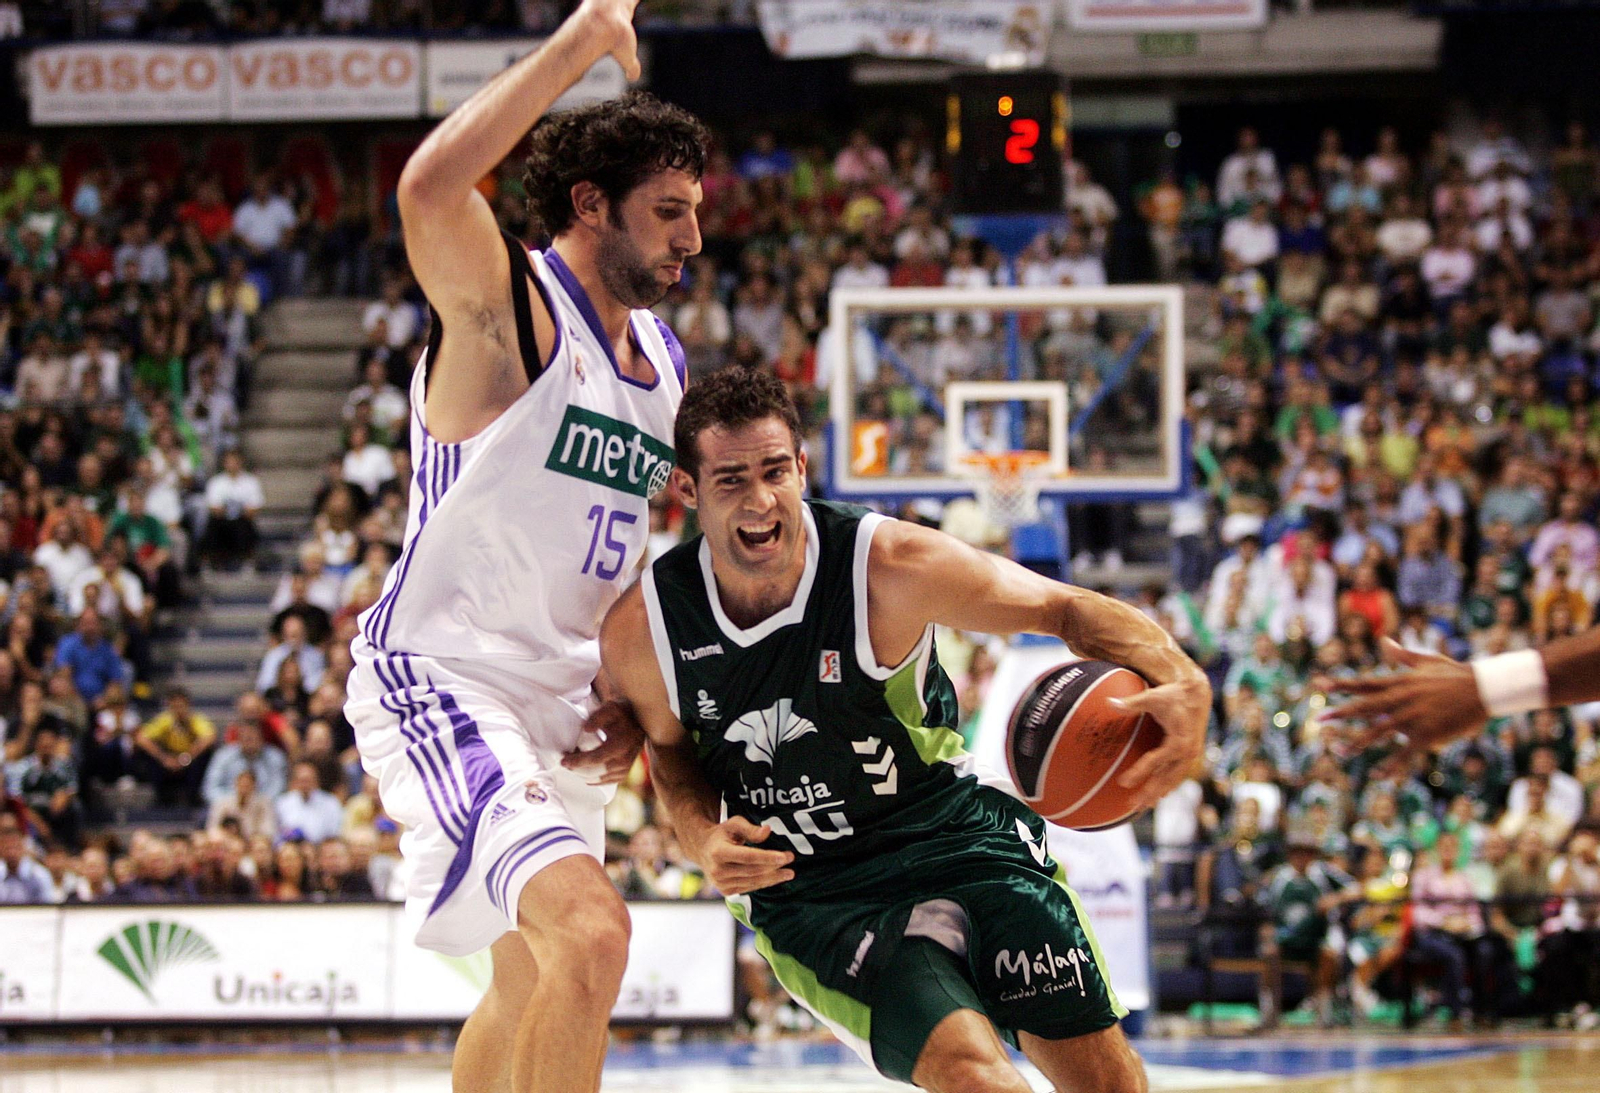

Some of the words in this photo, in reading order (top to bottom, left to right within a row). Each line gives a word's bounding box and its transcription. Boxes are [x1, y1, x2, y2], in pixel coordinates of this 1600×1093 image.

[36, 47, 219, 94] vasco
[233, 45, 414, 91] vasco
[1005, 119, 1040, 164] 2
[581, 505, 637, 581] 15
[1026, 667, 1084, 728] TOURNAMENT
[213, 970, 358, 1015] Unicaja
[999, 986, 1038, 1003] Ciudad
[1042, 976, 1078, 996] Genial
